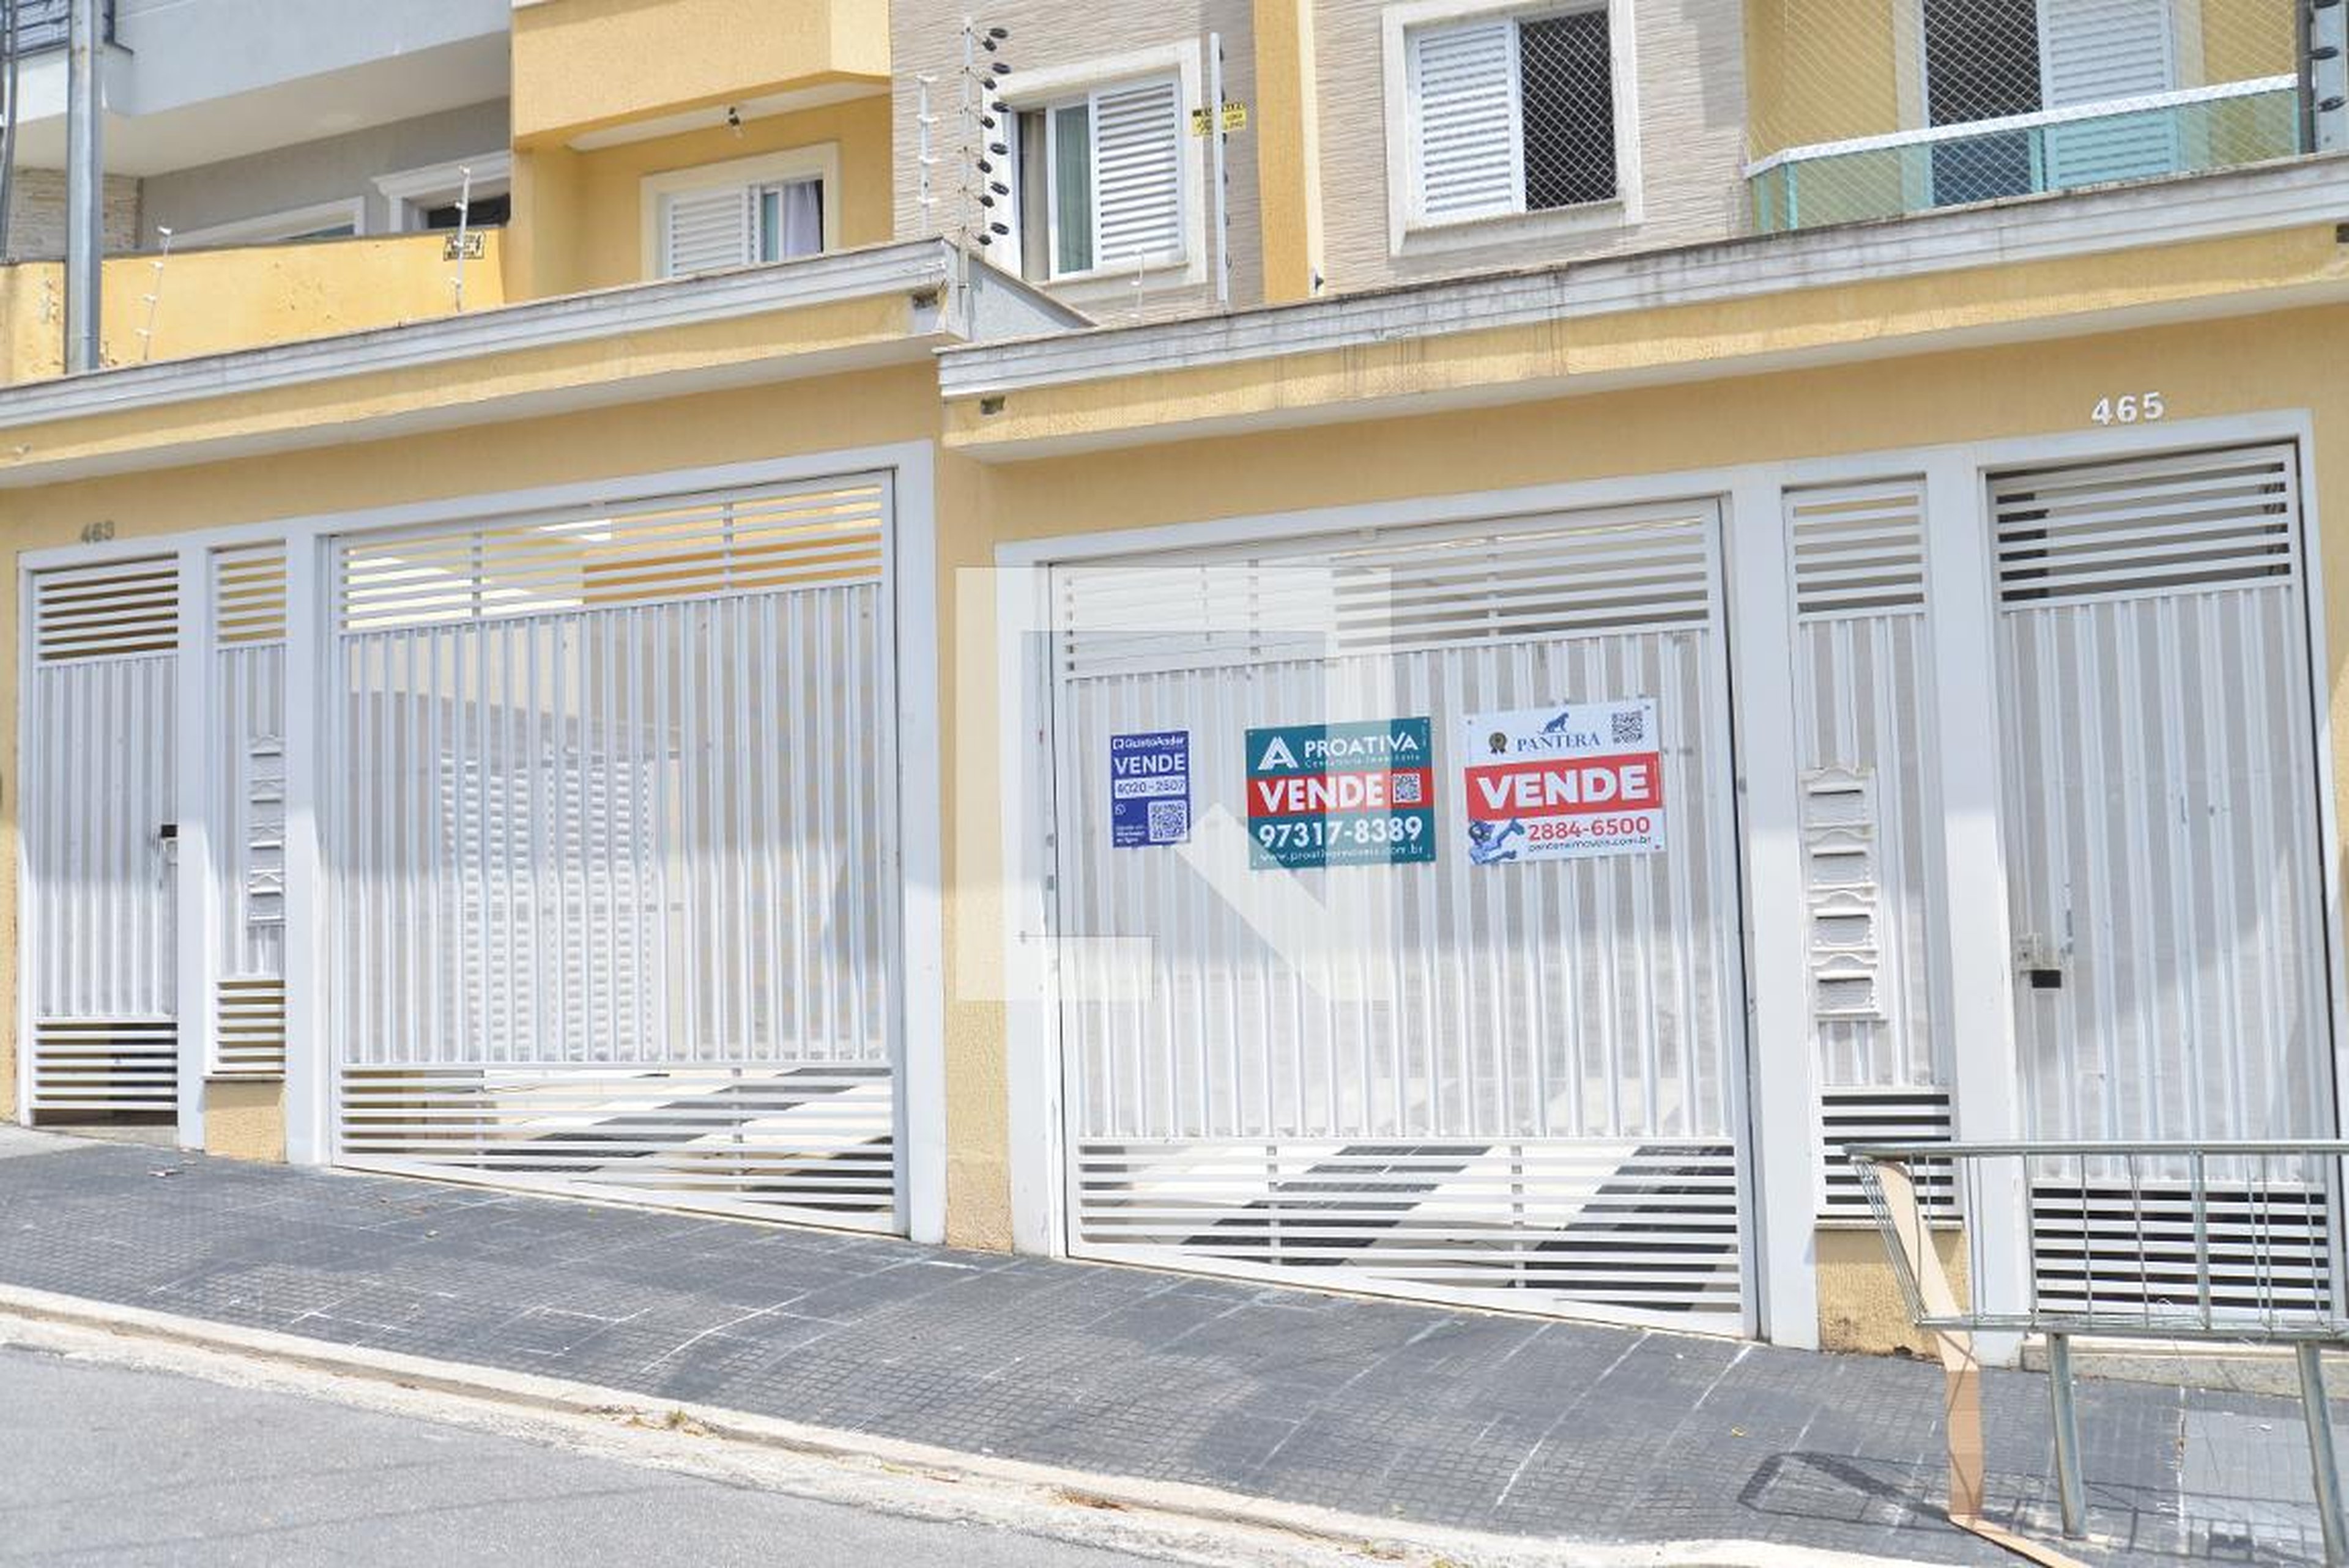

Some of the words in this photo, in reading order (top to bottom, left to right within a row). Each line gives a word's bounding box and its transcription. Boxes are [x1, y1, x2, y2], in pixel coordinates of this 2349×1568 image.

[2091, 391, 2164, 425] 465
[1304, 731, 1419, 758] PROATIVA
[1517, 733, 1601, 752] PANTERA
[1114, 753, 1186, 775] VENDE
[1257, 774, 1384, 813] VENDE
[1477, 764, 1650, 810] VENDE
[1258, 816, 1423, 848] 97317-8389
[1529, 816, 1650, 841] 2884-6500
